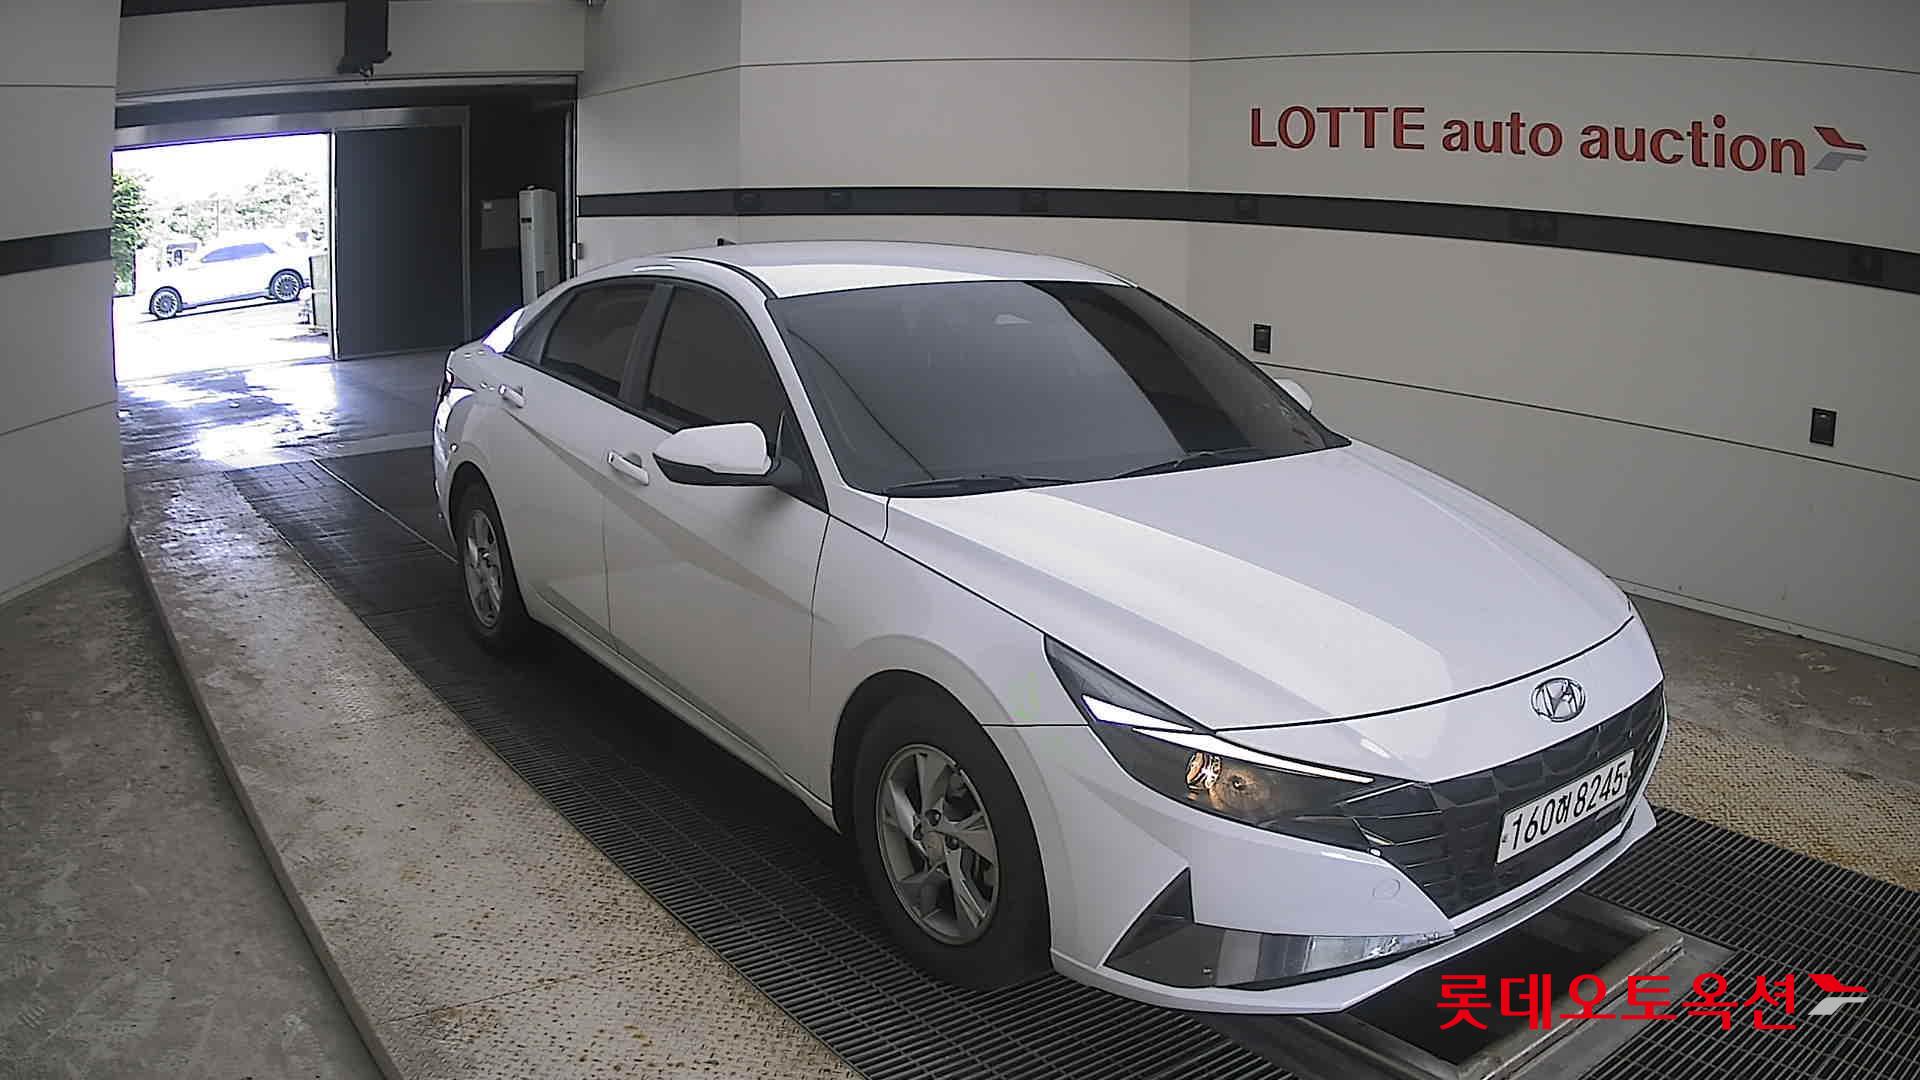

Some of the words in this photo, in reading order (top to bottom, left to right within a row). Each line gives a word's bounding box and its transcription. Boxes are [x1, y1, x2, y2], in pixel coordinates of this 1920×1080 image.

[1250, 106, 1425, 150] LOTTE
[1442, 111, 1563, 157] auto
[1580, 114, 1807, 177] auction
